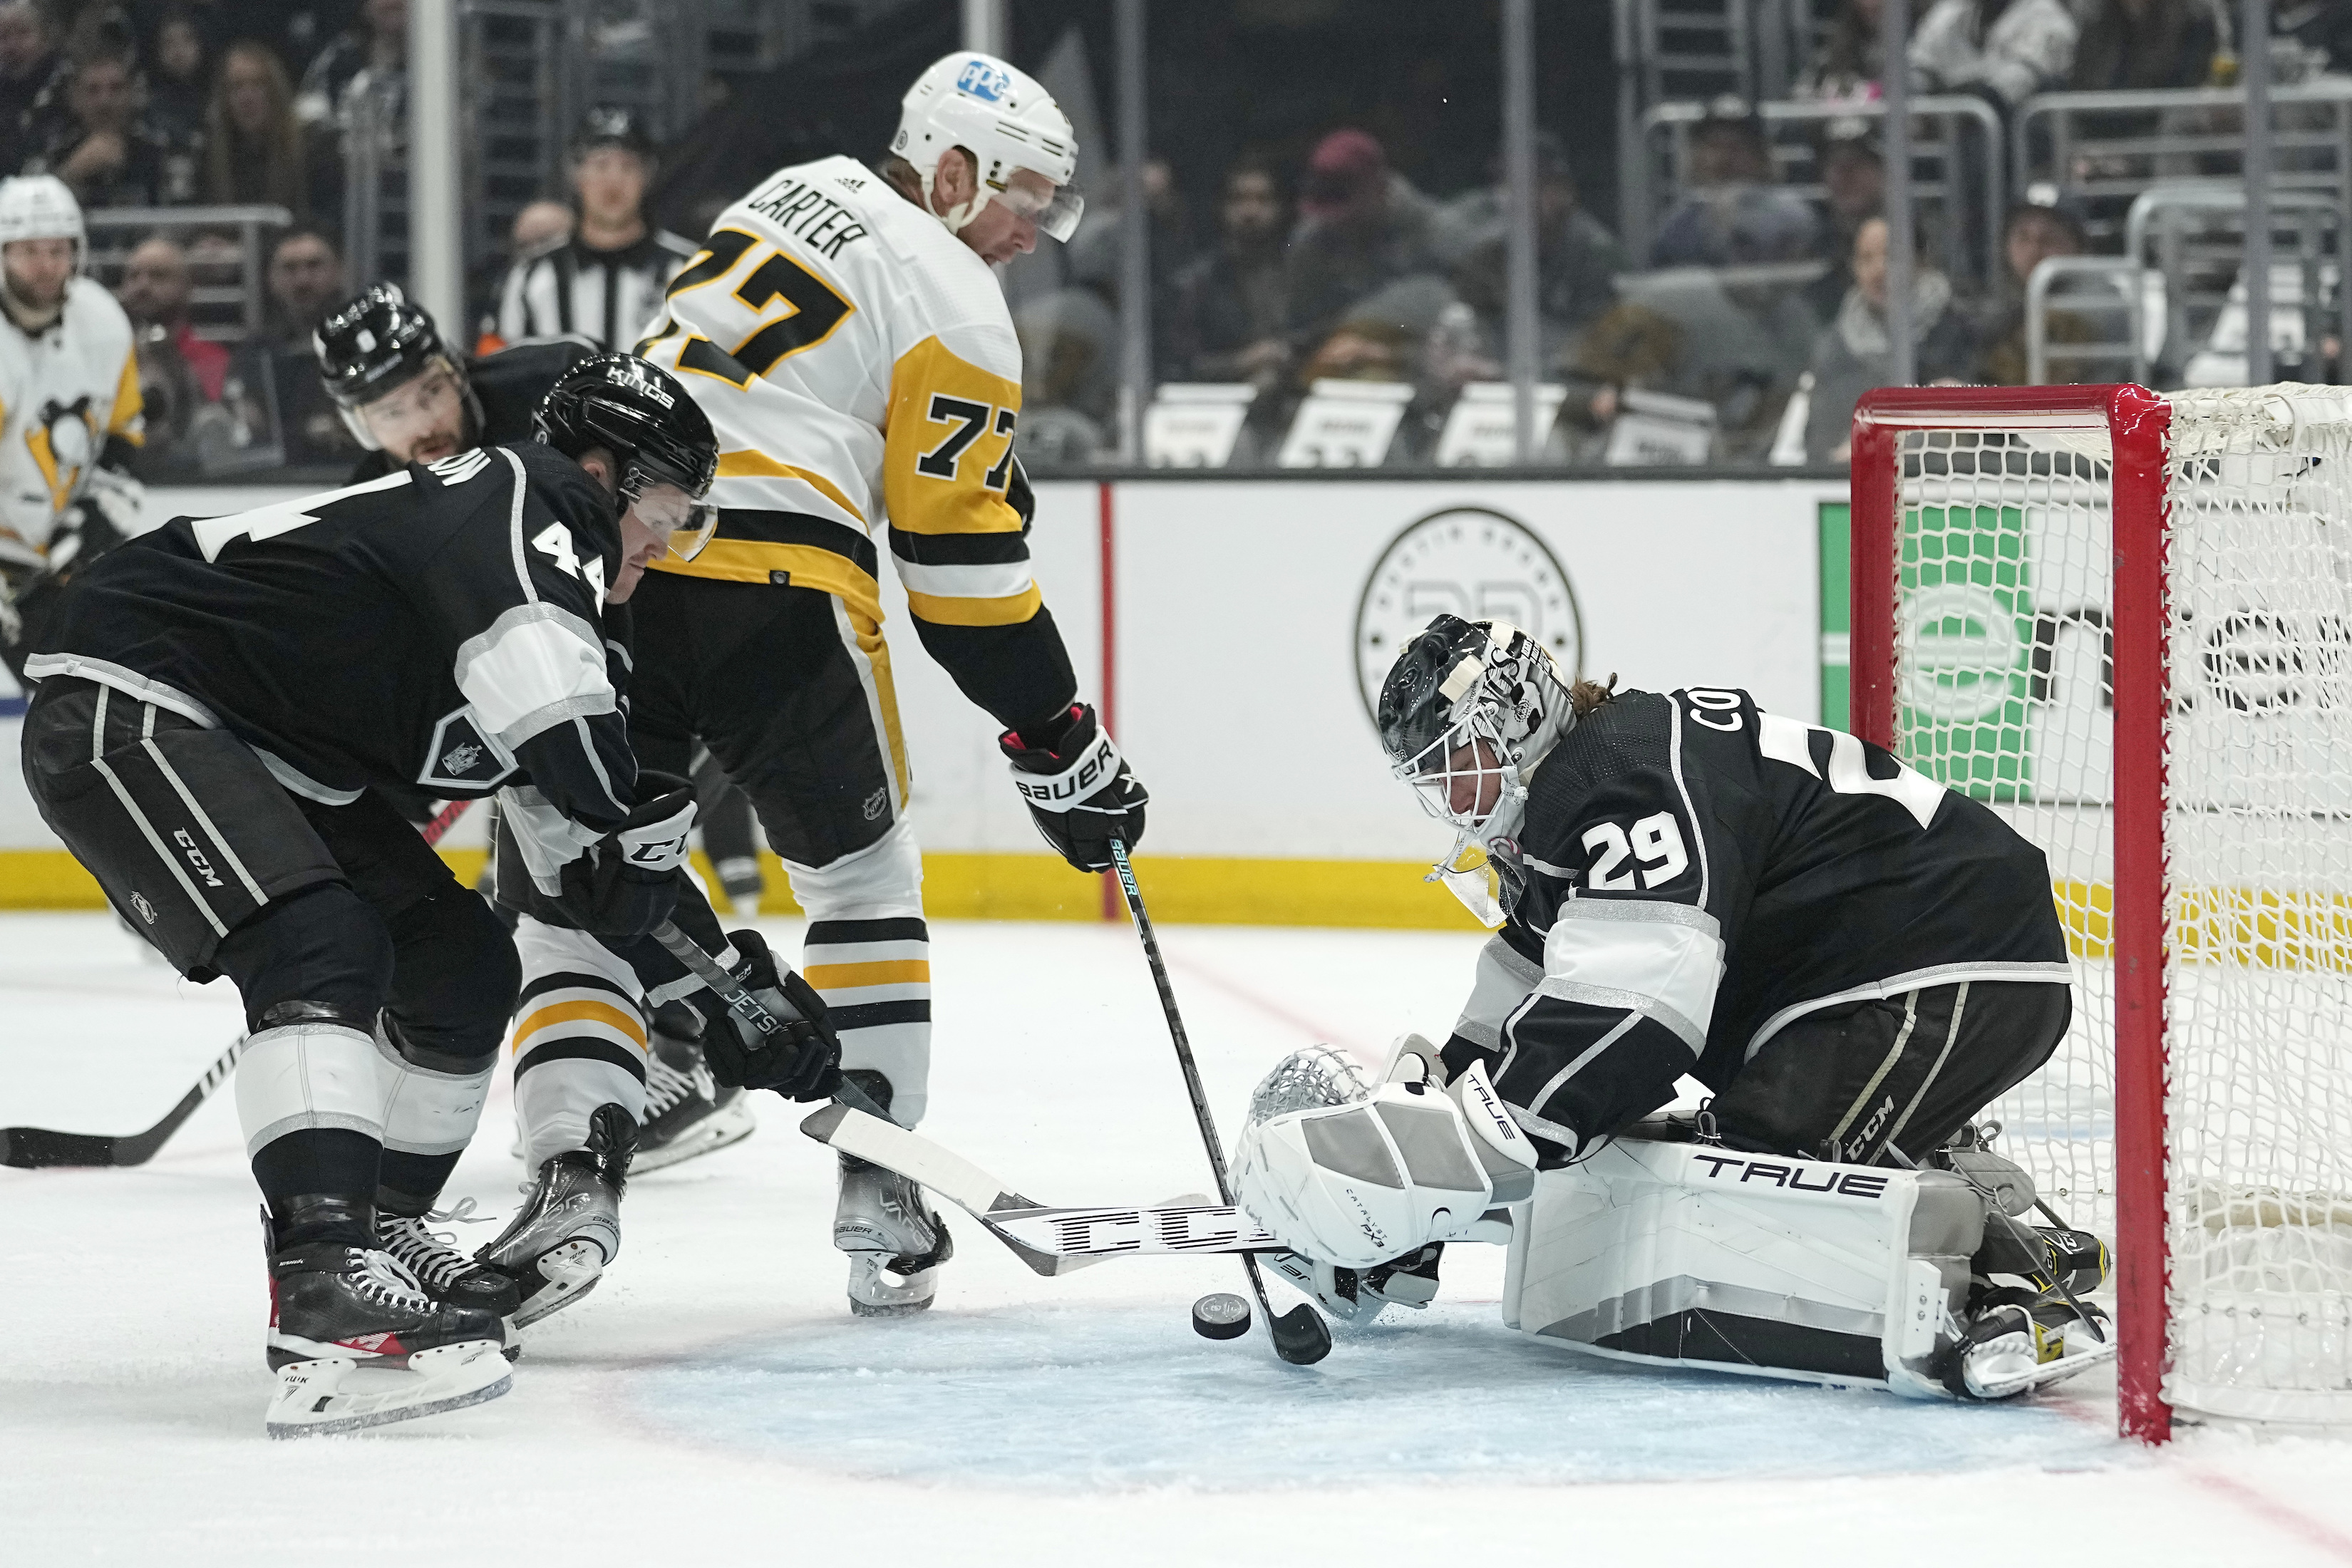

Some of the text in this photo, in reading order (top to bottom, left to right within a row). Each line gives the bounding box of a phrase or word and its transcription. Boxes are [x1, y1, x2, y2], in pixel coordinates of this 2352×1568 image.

[748, 180, 869, 261] CARTER
[607, 366, 676, 411] KINGS
[427, 447, 492, 487] ON
[915, 392, 1018, 492] 77
[532, 520, 607, 619] 44
[1685, 685, 1743, 732] CO
[1015, 739, 1114, 801] BAUER
[173, 827, 225, 887] CCM
[1109, 838, 1139, 896] BAUER
[1580, 810, 1689, 891] 29
[1468, 1073, 1516, 1140] TRUE
[1845, 1095, 1895, 1162] CCM
[1692, 1154, 1889, 1200] TRUE
[1042, 1205, 1276, 1254] CC
[1346, 1188, 1388, 1239] CATALYST
